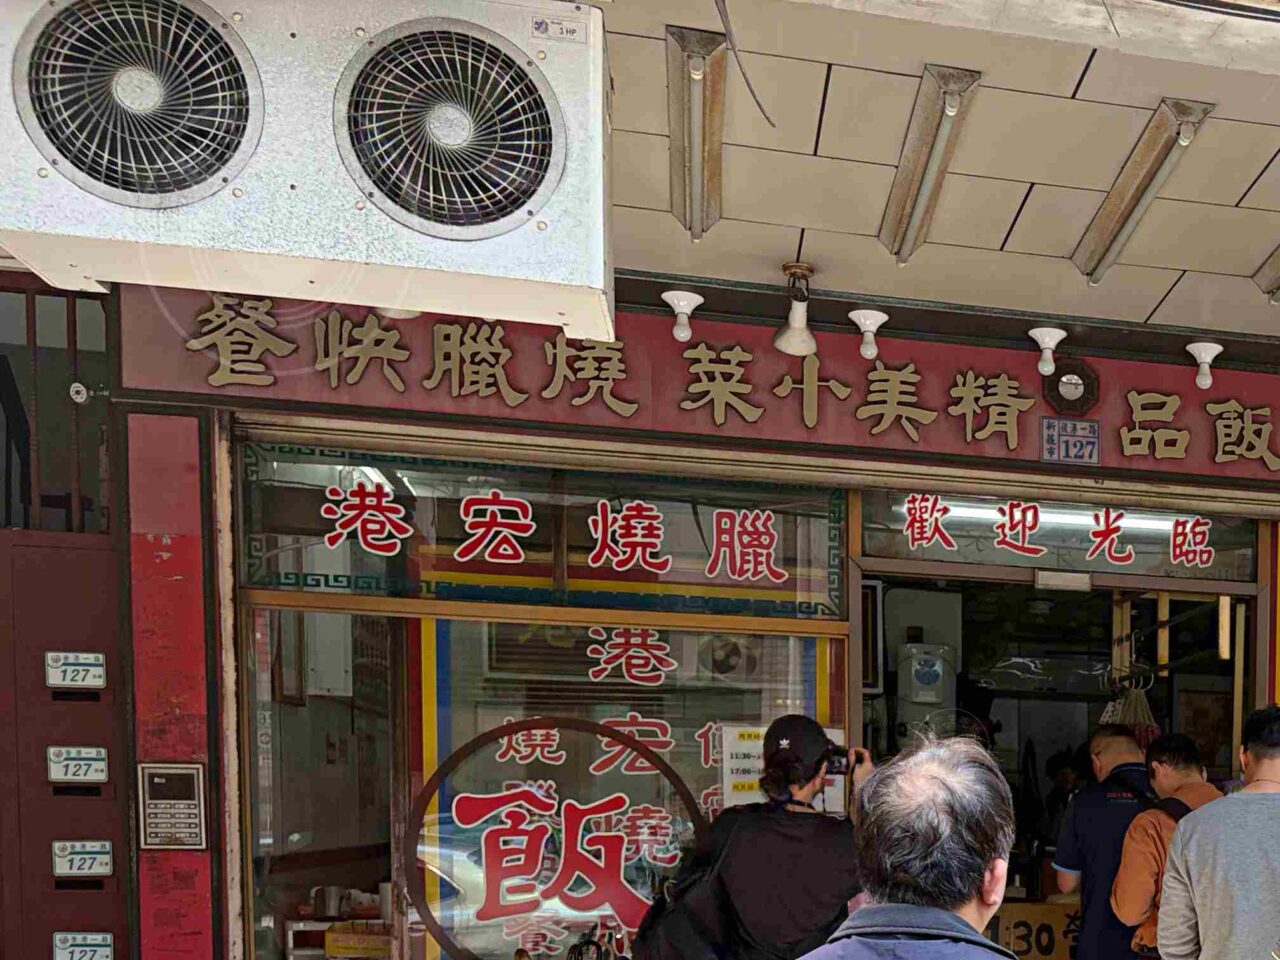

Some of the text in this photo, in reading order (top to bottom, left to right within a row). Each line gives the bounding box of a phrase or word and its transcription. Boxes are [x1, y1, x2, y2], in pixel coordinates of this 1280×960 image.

[1061, 439, 1097, 460] 127
[320, 480, 789, 586] 港宏燒臘
[903, 491, 1216, 569] 歡迎光臨
[60, 668, 91, 682] 127
[62, 763, 92, 777] 127
[67, 857, 97, 871] 127
[452, 786, 653, 932] 飯
